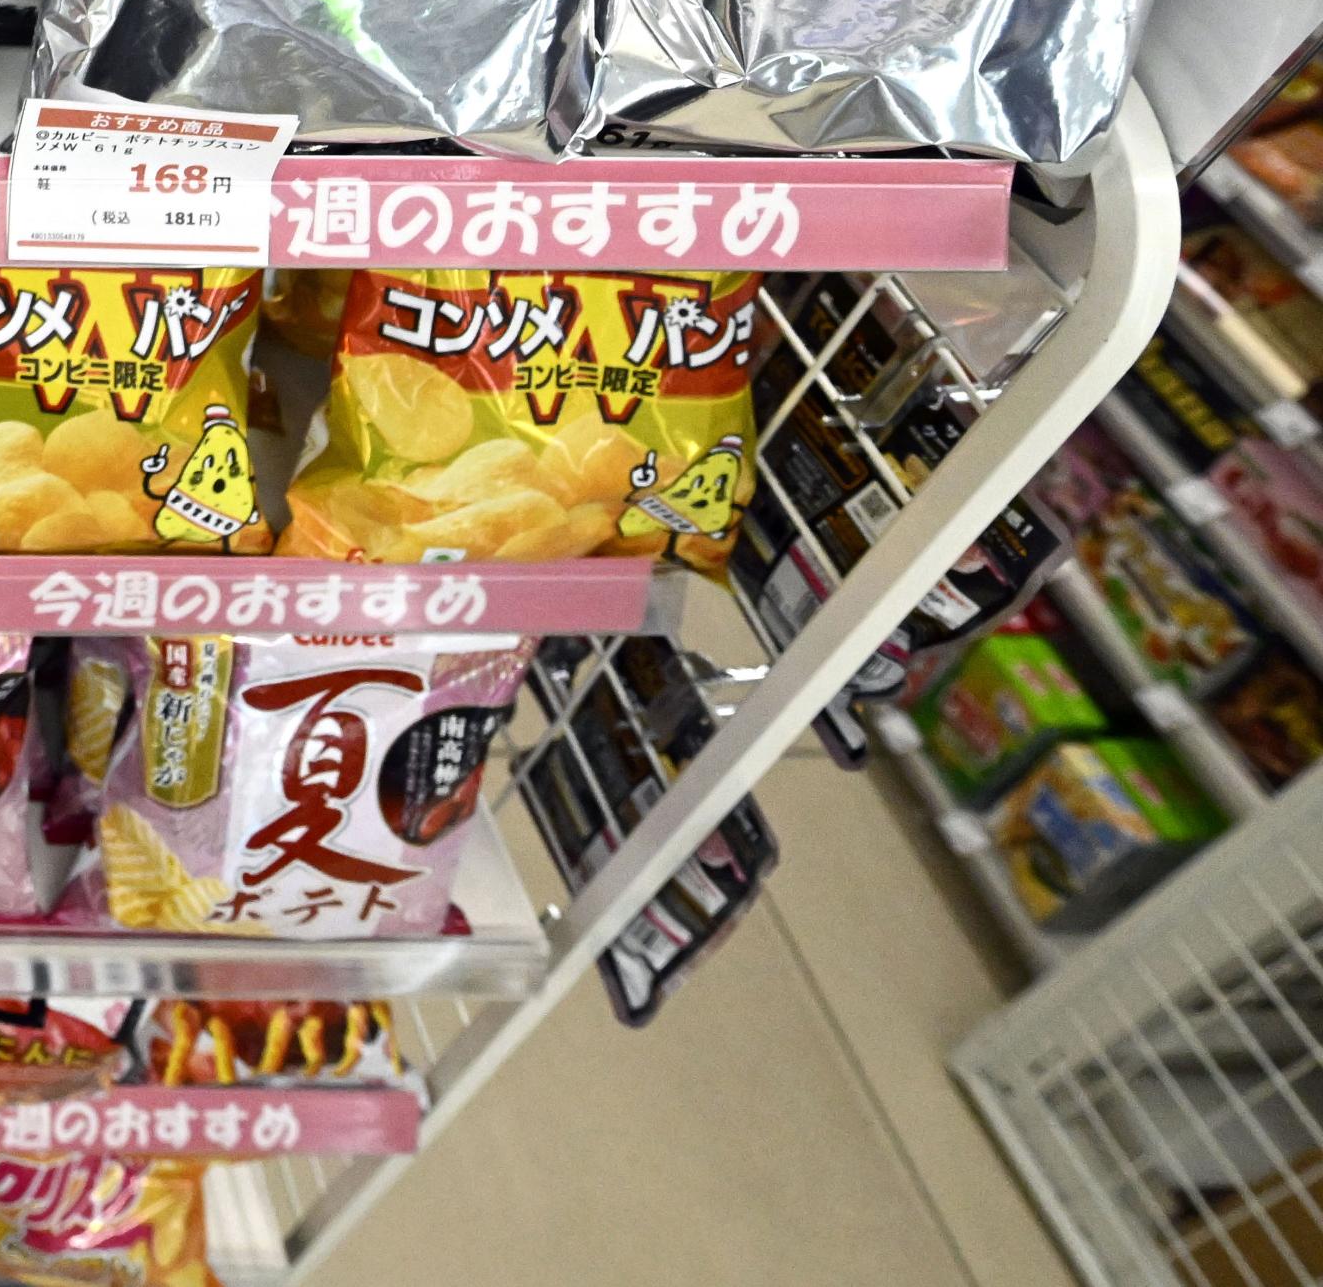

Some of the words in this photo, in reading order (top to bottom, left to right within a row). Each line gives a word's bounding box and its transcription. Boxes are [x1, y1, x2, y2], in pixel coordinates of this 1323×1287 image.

[90, 112, 224, 136] おすすめ商品
[271, 177, 801, 260] 週のおすすめ
[18, 355, 166, 394] コンビニ限定
[513, 362, 660, 399] コンビニ限定
[172, 496, 237, 536] POTATO
[28, 572, 488, 628] 今週のおすすめ
[242, 667, 429, 884] 夏
[209, 884, 400, 927] ポテト
